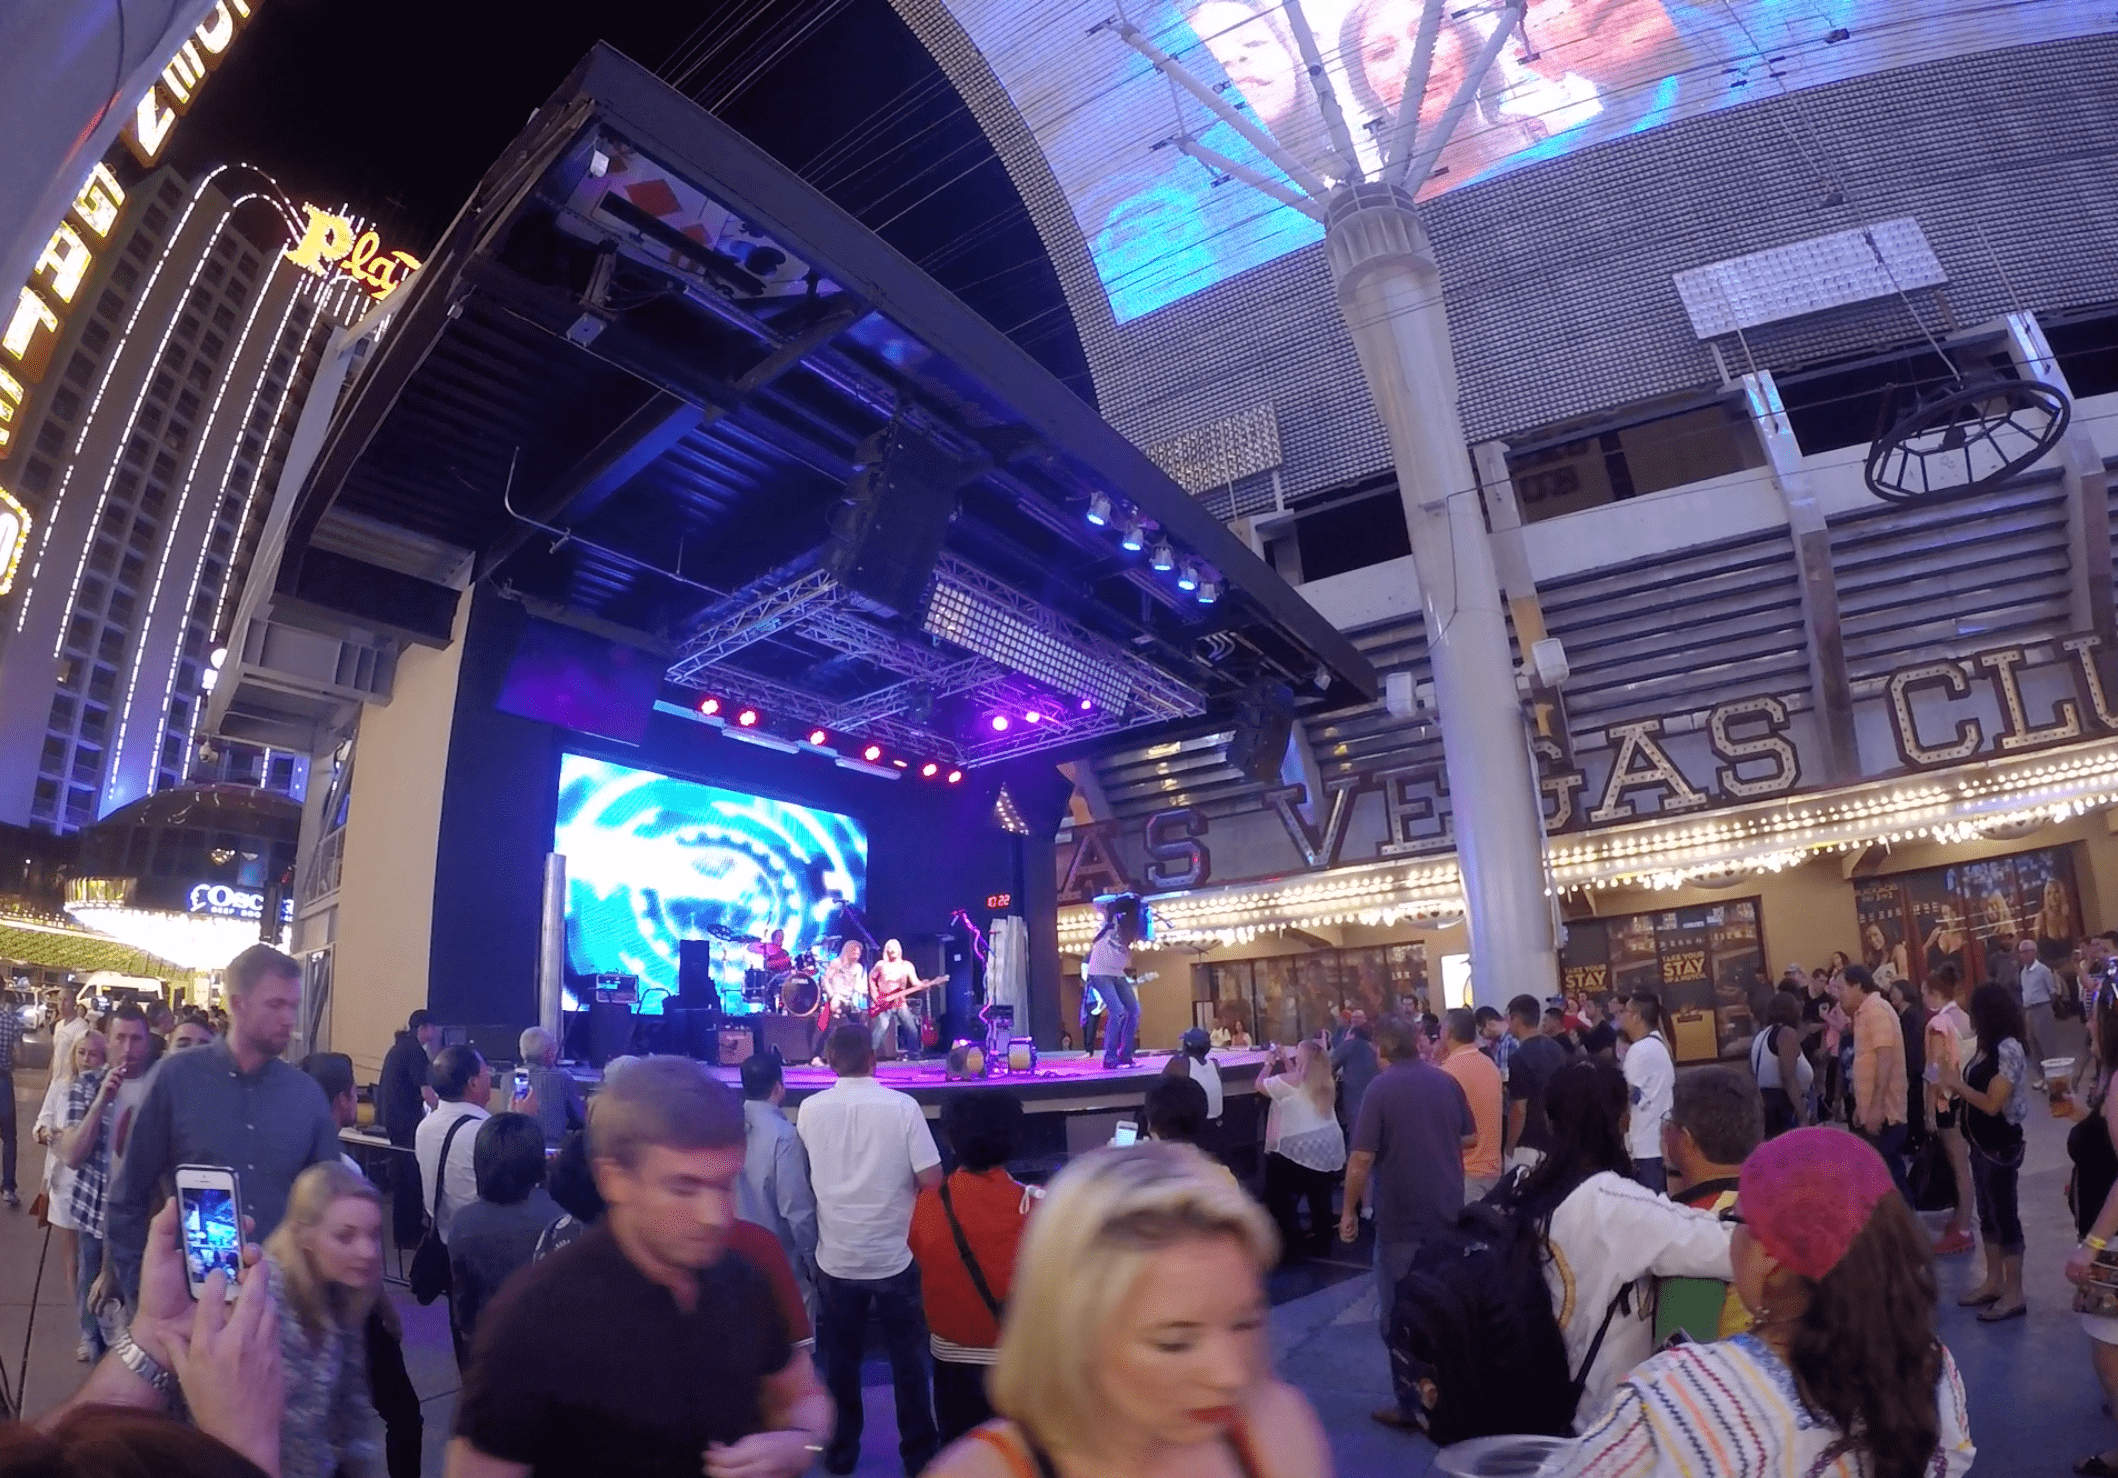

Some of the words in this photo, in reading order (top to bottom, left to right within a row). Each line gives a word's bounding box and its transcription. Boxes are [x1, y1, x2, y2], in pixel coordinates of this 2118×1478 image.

[136, 0, 252, 157] DEN
[284, 202, 422, 300] Pla
[1058, 806, 1210, 903] AS
[1565, 970, 1607, 989] STAY
[1663, 957, 1705, 976] STAY
